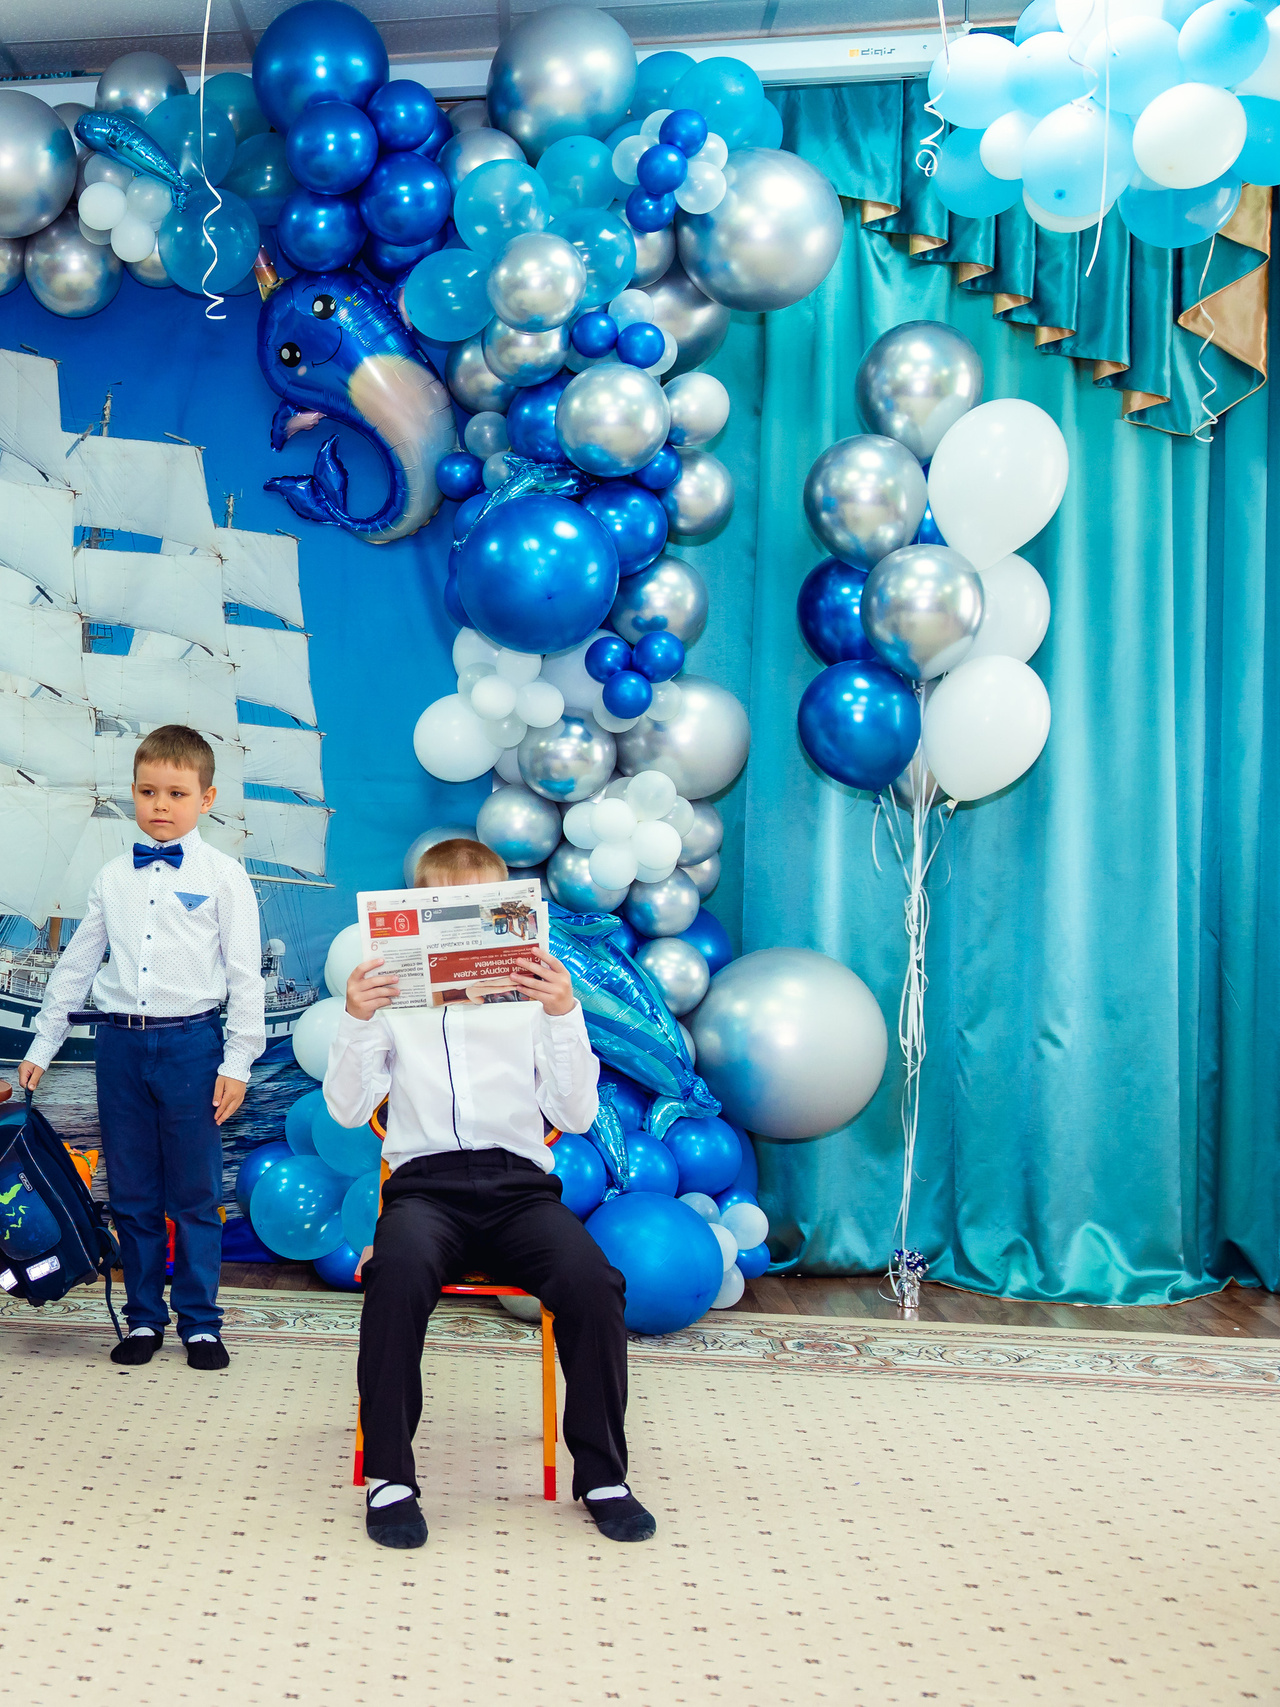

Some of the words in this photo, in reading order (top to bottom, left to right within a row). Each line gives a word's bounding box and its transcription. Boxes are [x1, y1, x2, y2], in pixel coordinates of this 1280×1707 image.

[861, 48, 896, 56] digis
[424, 910, 432, 921] 6
[371, 941, 378, 951] 9
[430, 957, 437, 967] 2
[474, 957, 532, 968] неерпением
[454, 970, 477, 978] ждем
[480, 966, 509, 976] корпус
